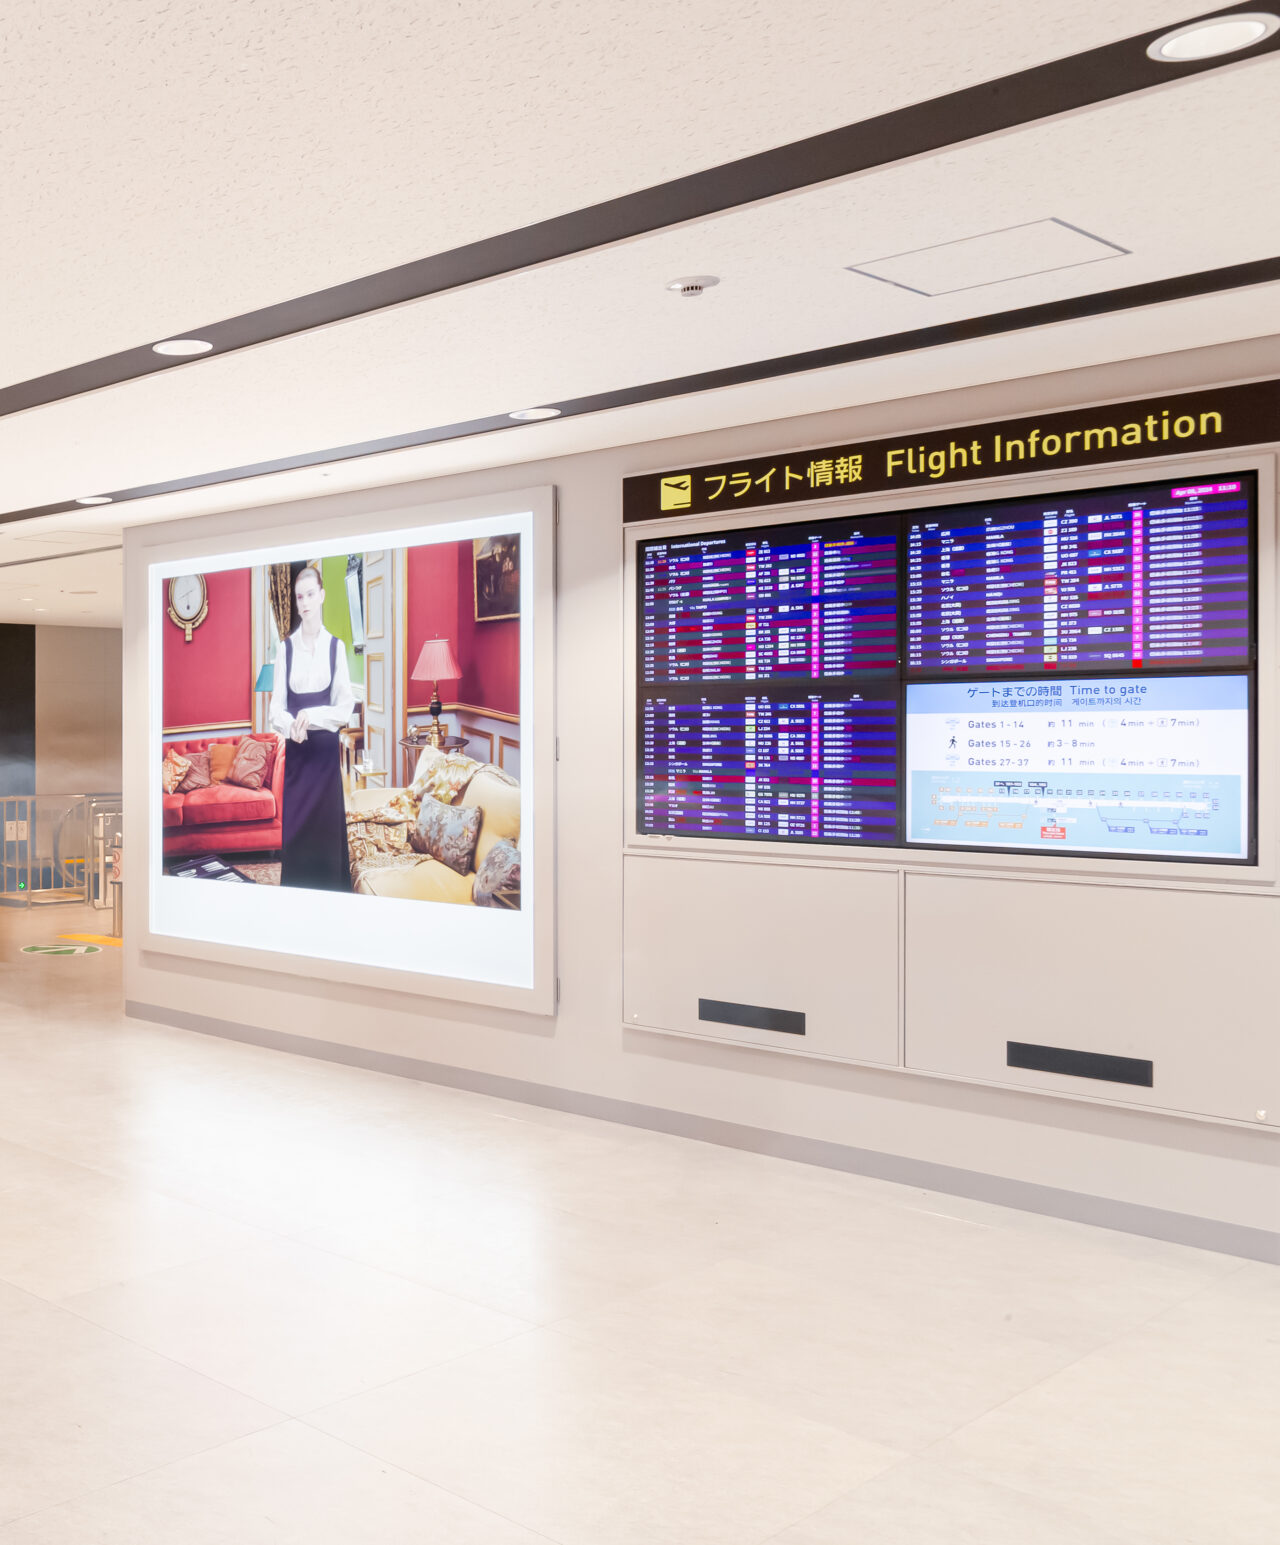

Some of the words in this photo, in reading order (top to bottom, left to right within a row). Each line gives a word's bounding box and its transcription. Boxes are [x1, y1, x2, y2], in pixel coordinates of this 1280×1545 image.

[886, 440, 982, 480] Flight
[994, 410, 1224, 464] Information
[704, 454, 863, 500] フライト情報
[967, 685, 1062, 698] ゲートまでの時間
[1070, 685, 1100, 695] Time
[1104, 685, 1116, 695] to
[1120, 684, 1147, 697] gate
[1124, 697, 1142, 706] 시간
[968, 720, 997, 729] Gates
[1061, 719, 1072, 728] 11
[968, 739, 997, 748] Gates
[968, 757, 997, 766] Gates
[1061, 757, 1072, 766] 11
